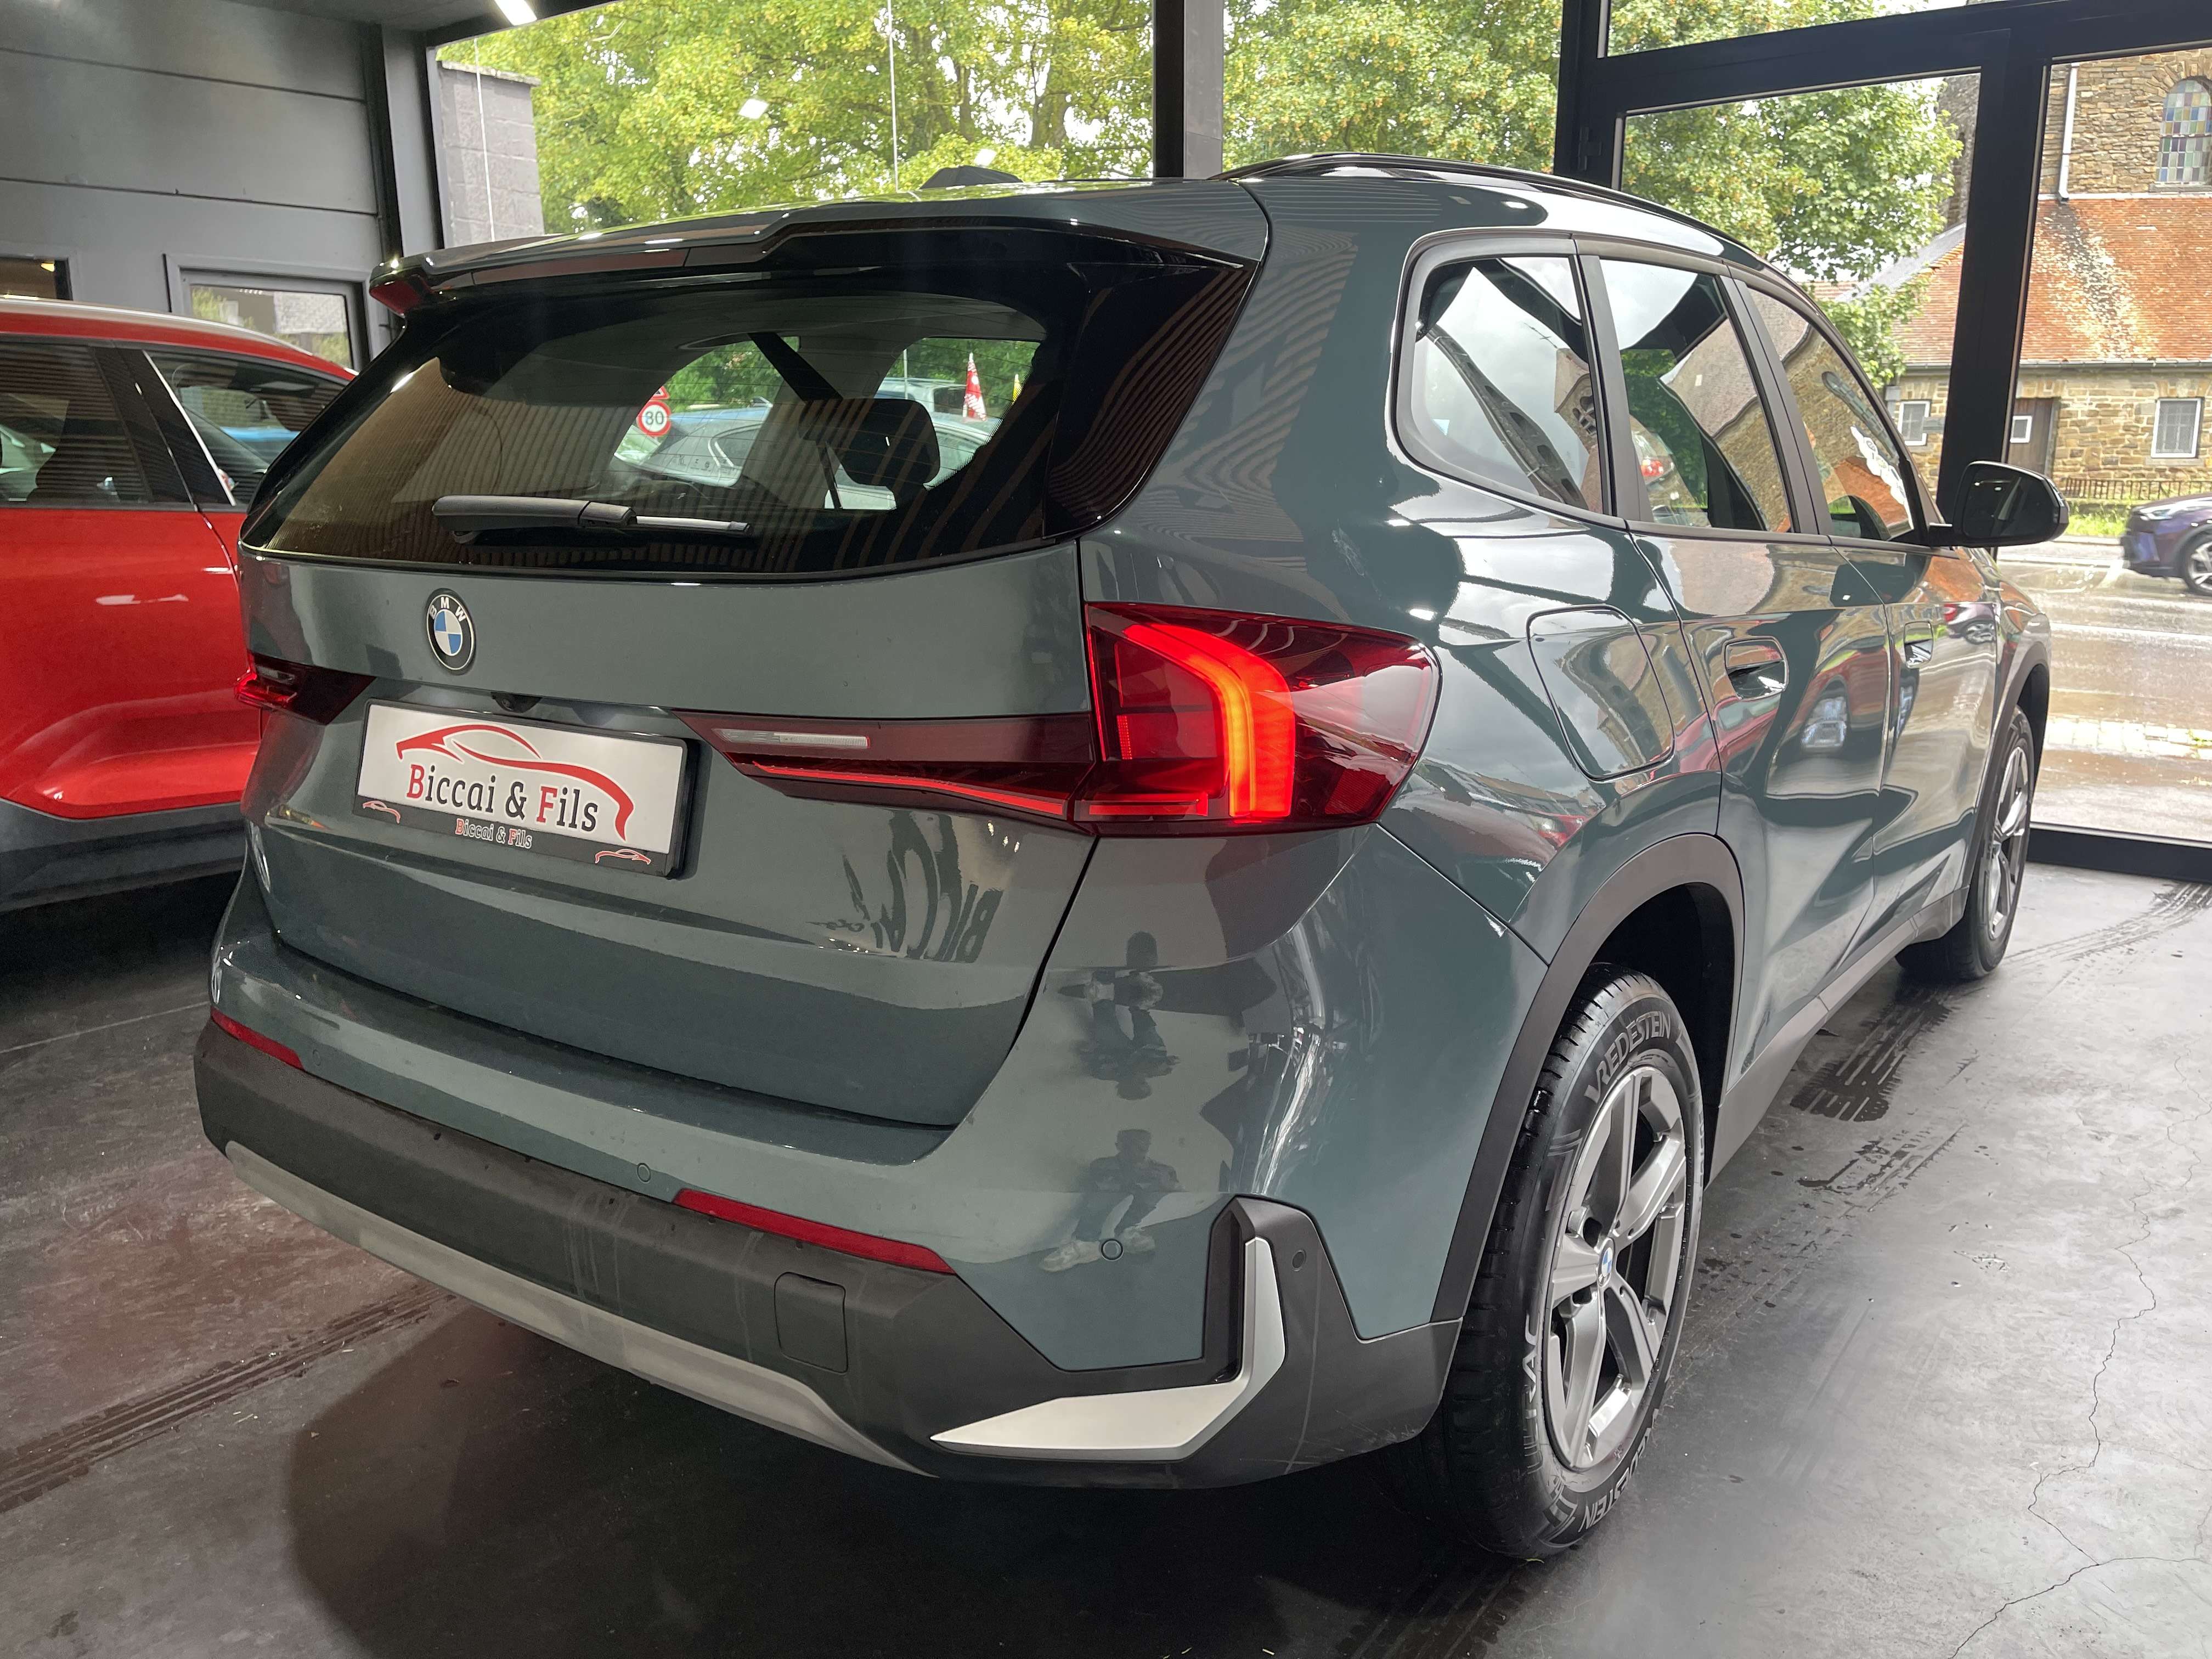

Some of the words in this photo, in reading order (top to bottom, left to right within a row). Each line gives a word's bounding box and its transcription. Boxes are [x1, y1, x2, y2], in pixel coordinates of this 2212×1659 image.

[646, 411, 664, 425] 30
[429, 596, 466, 622] BMW
[407, 764, 495, 813] Biccai
[505, 781, 527, 820] &
[537, 786, 599, 832] Fils
[455, 818, 494, 841] Biccai
[495, 826, 506, 844] &
[507, 828, 532, 849] Fils
[1584, 1011, 1671, 1103] VREDESTEIN
